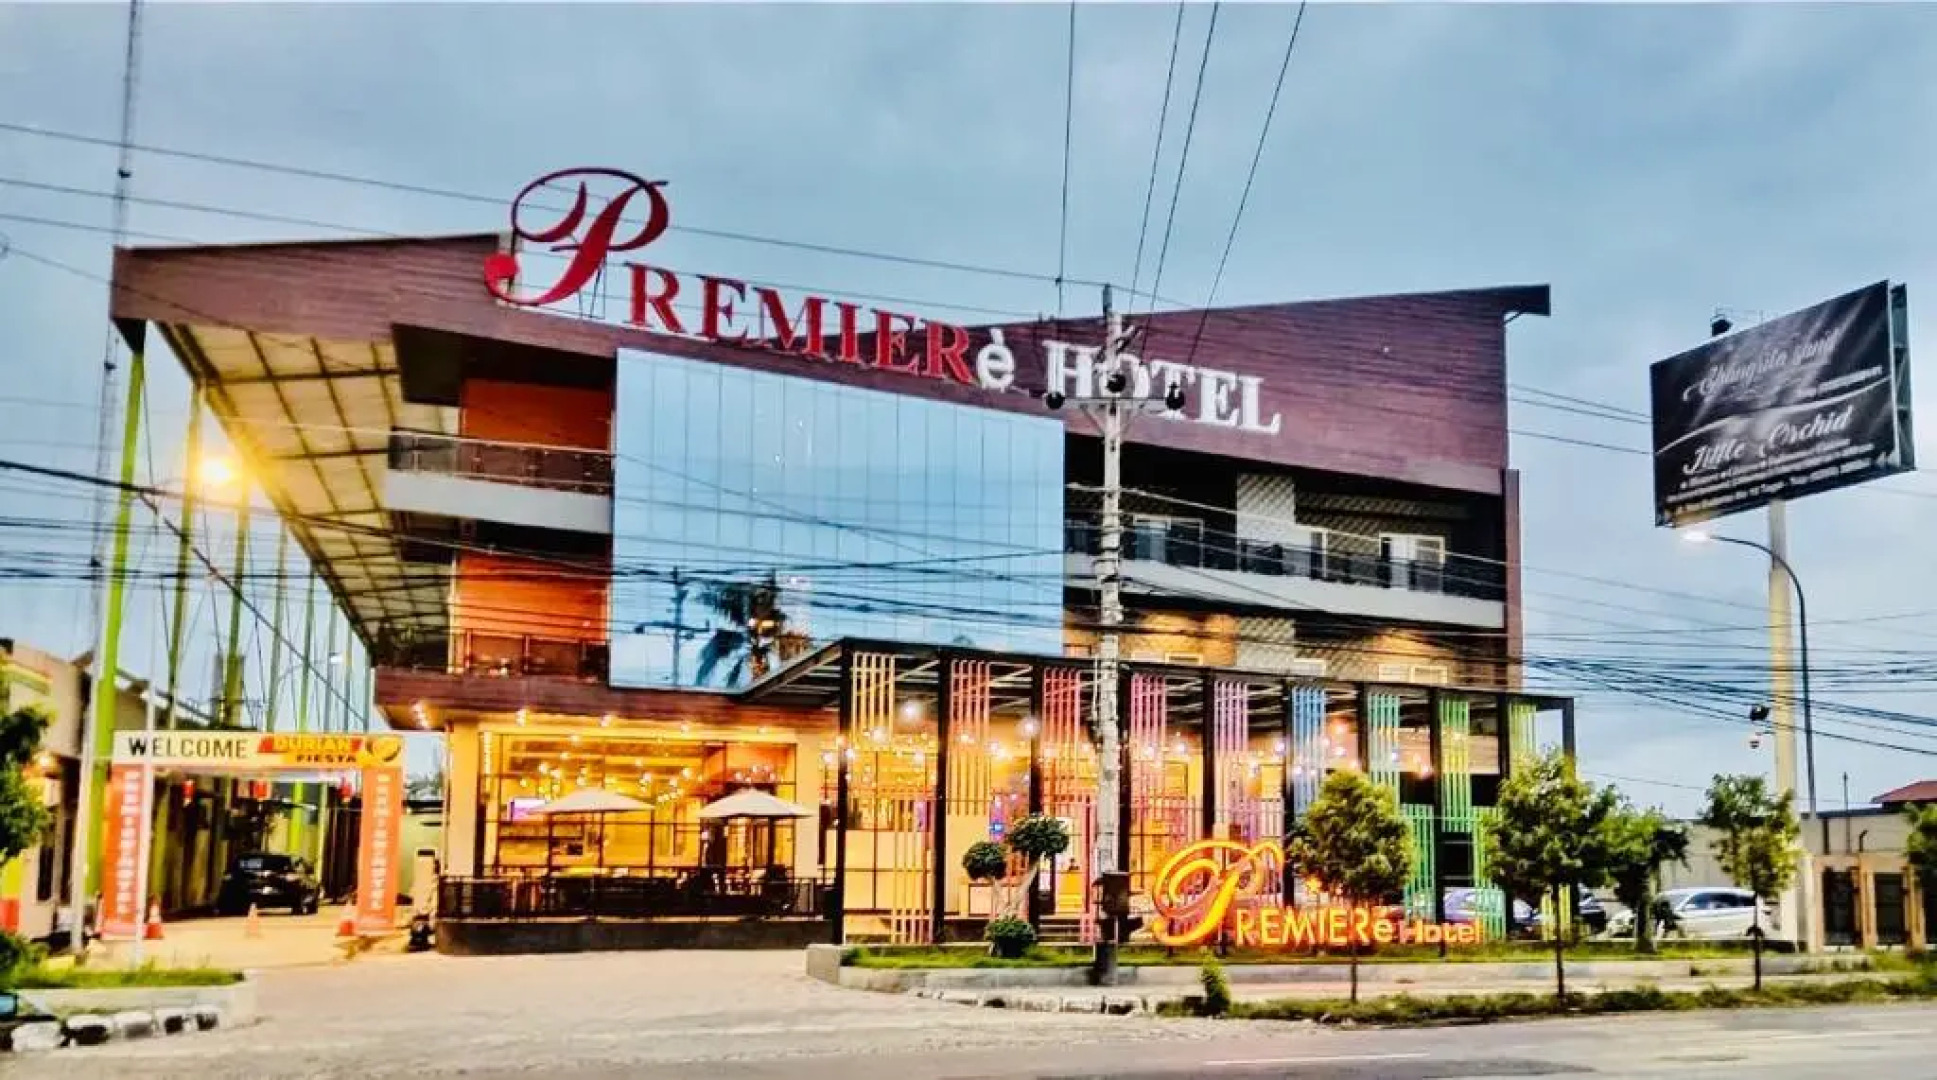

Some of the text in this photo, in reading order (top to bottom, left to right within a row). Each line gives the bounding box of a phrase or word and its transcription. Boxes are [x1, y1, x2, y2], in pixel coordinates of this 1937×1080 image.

[1041, 338, 1281, 434] HOTEL
[1758, 404, 1854, 457] Orchid
[128, 737, 248, 758] WELCOME
[296, 753, 357, 763] FIESTA
[1400, 917, 1484, 944] Hotel
